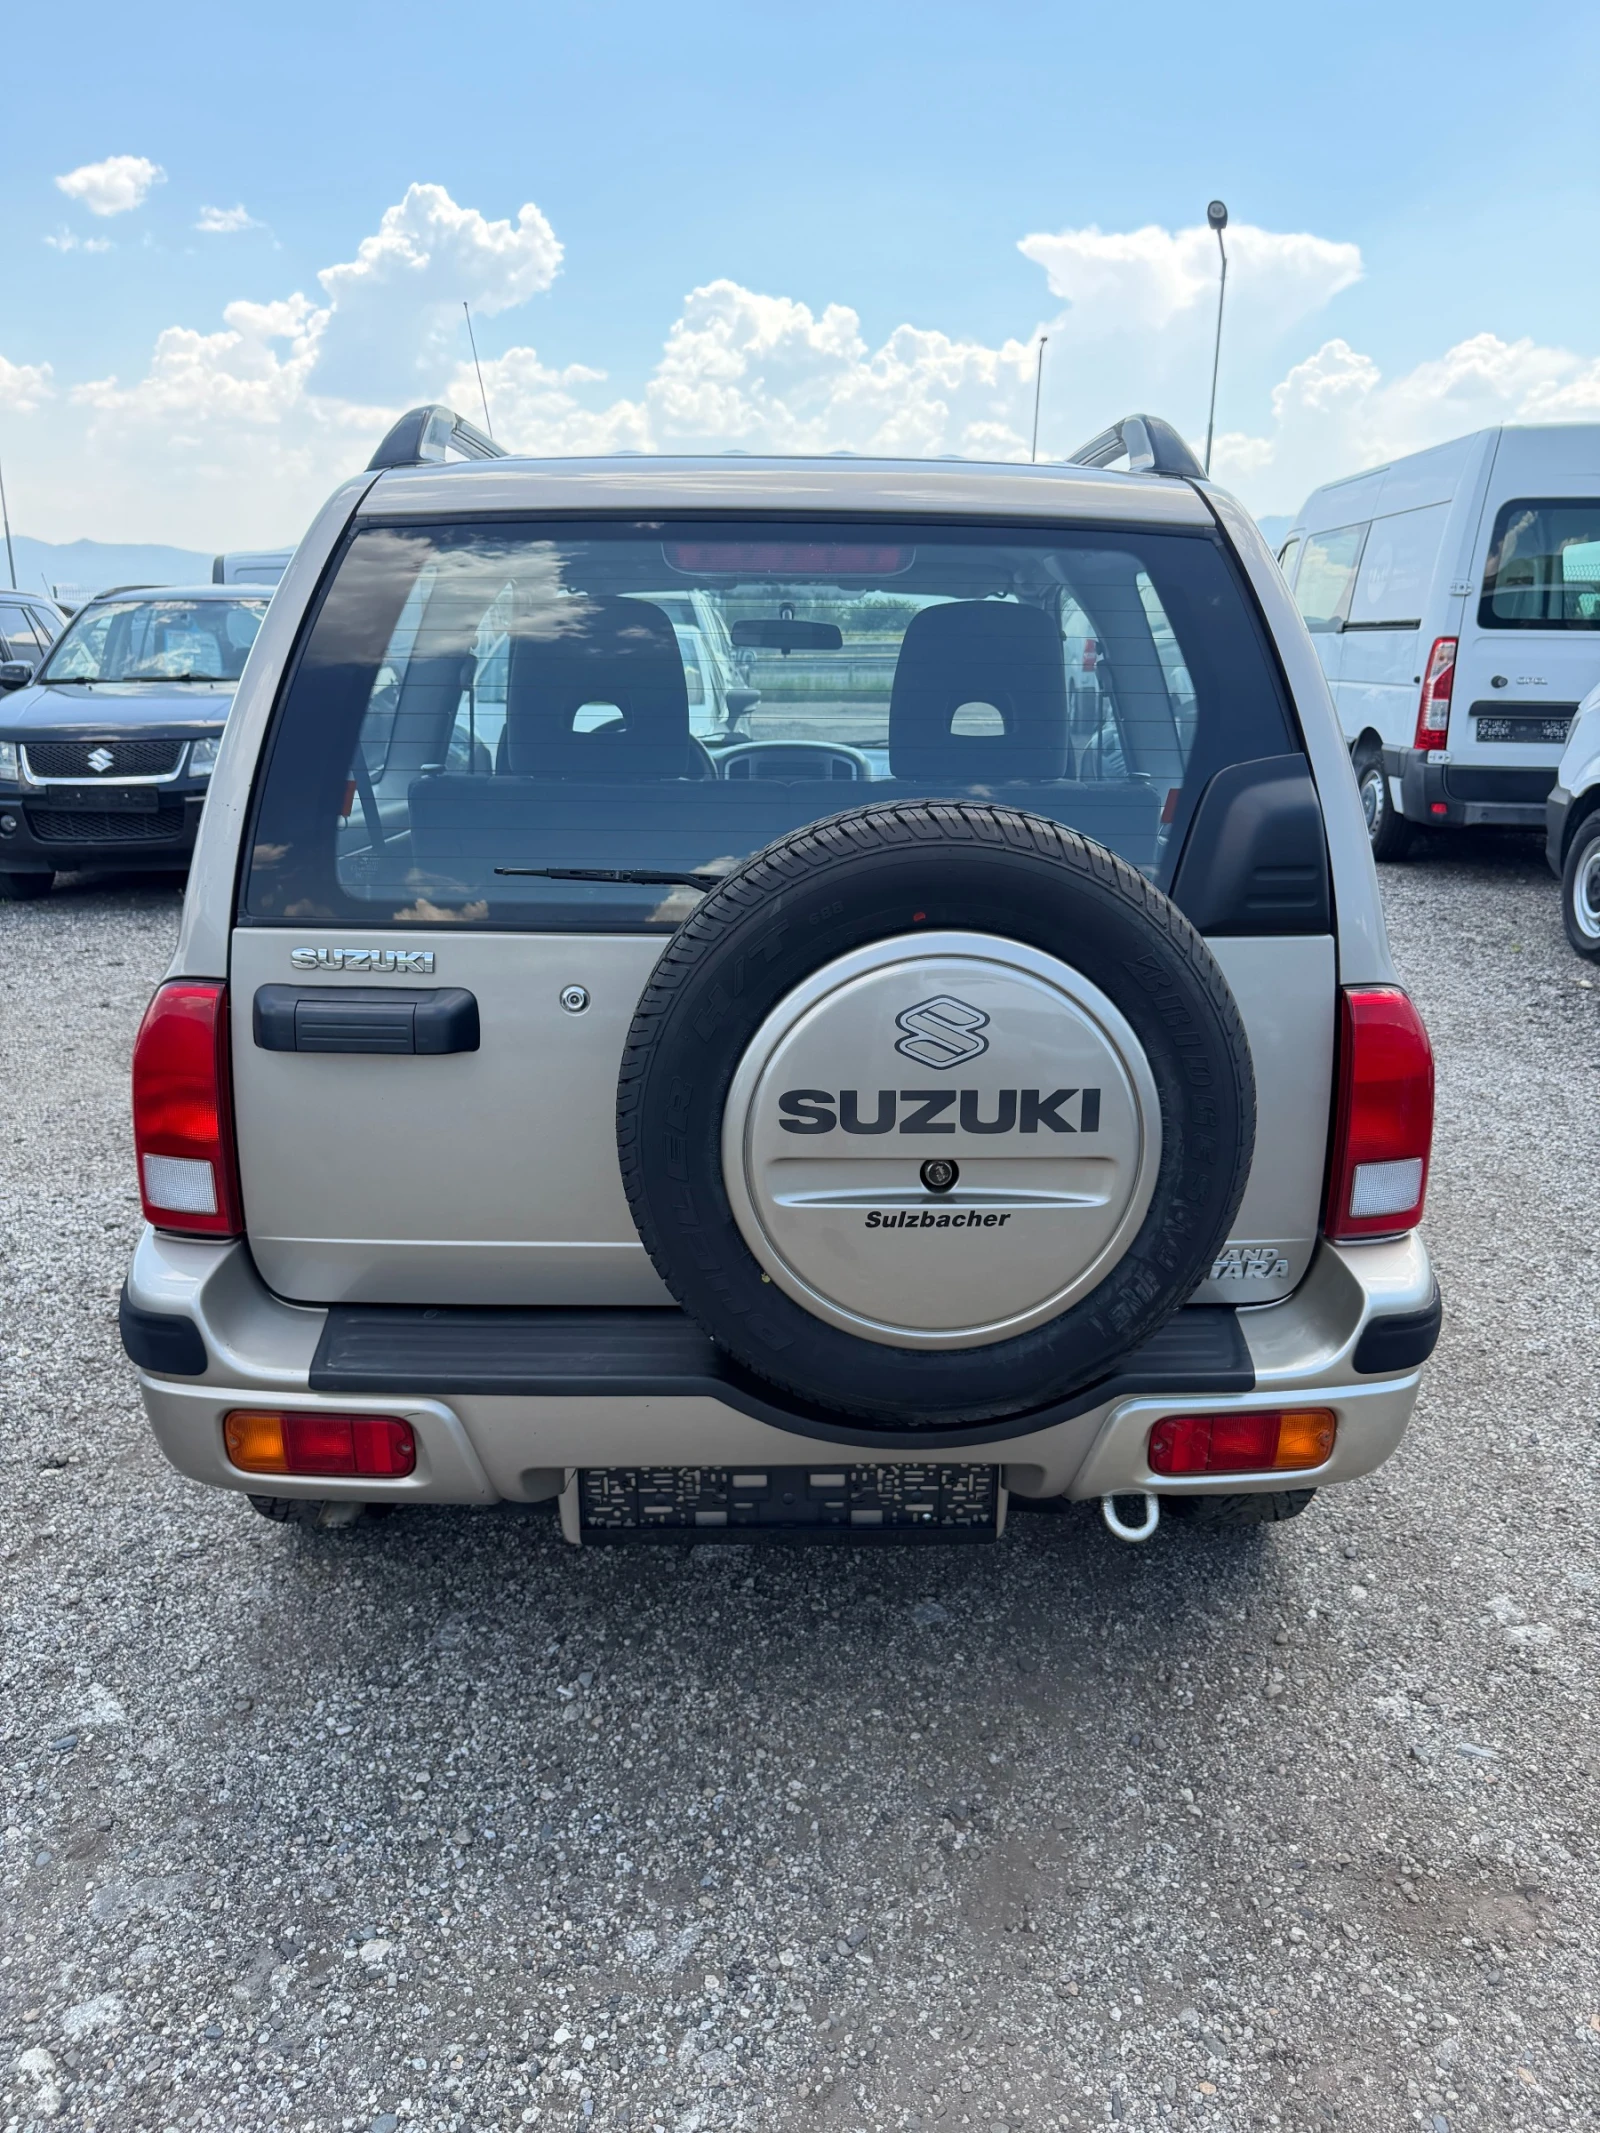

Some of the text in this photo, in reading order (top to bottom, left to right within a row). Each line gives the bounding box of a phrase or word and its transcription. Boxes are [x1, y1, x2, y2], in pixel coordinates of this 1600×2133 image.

[1516, 676, 1548, 685] OPEL
[808, 900, 844, 926] 688
[291, 948, 435, 973] SUZUKI
[778, 1088, 1101, 1135] SUZUKI
[864, 1210, 1011, 1228] Sulzbacher
[1217, 1248, 1279, 1262] AND
